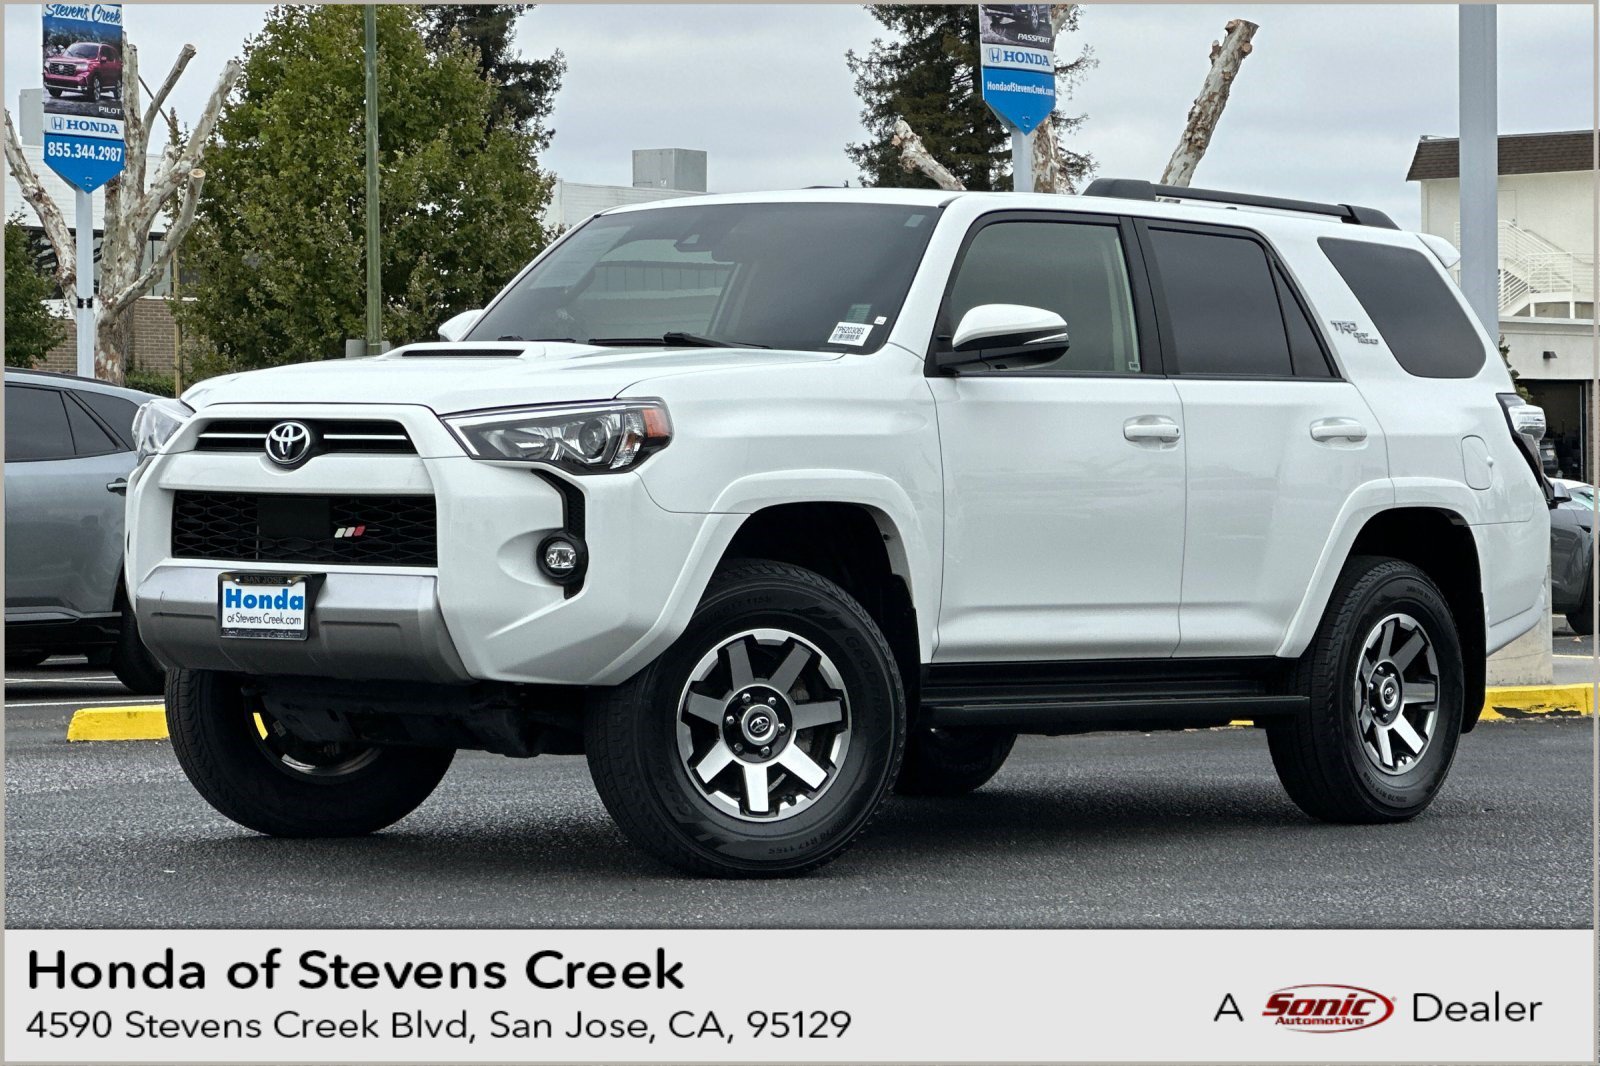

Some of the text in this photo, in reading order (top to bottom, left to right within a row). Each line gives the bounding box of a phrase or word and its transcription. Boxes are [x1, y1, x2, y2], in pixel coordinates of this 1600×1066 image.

[45, 4, 121, 24] Stevens Creek
[1017, 33, 1050, 43] PASSPORT
[1003, 50, 1050, 67] HONDA
[987, 81, 1054, 97] HondaofStevensCreek.com
[98, 106, 121, 115] PILOT
[66, 119, 119, 135] HONDA
[47, 141, 122, 163] 855.344.2987
[225, 588, 304, 611] Honda
[227, 612, 302, 625] of Stevens Creek.com
